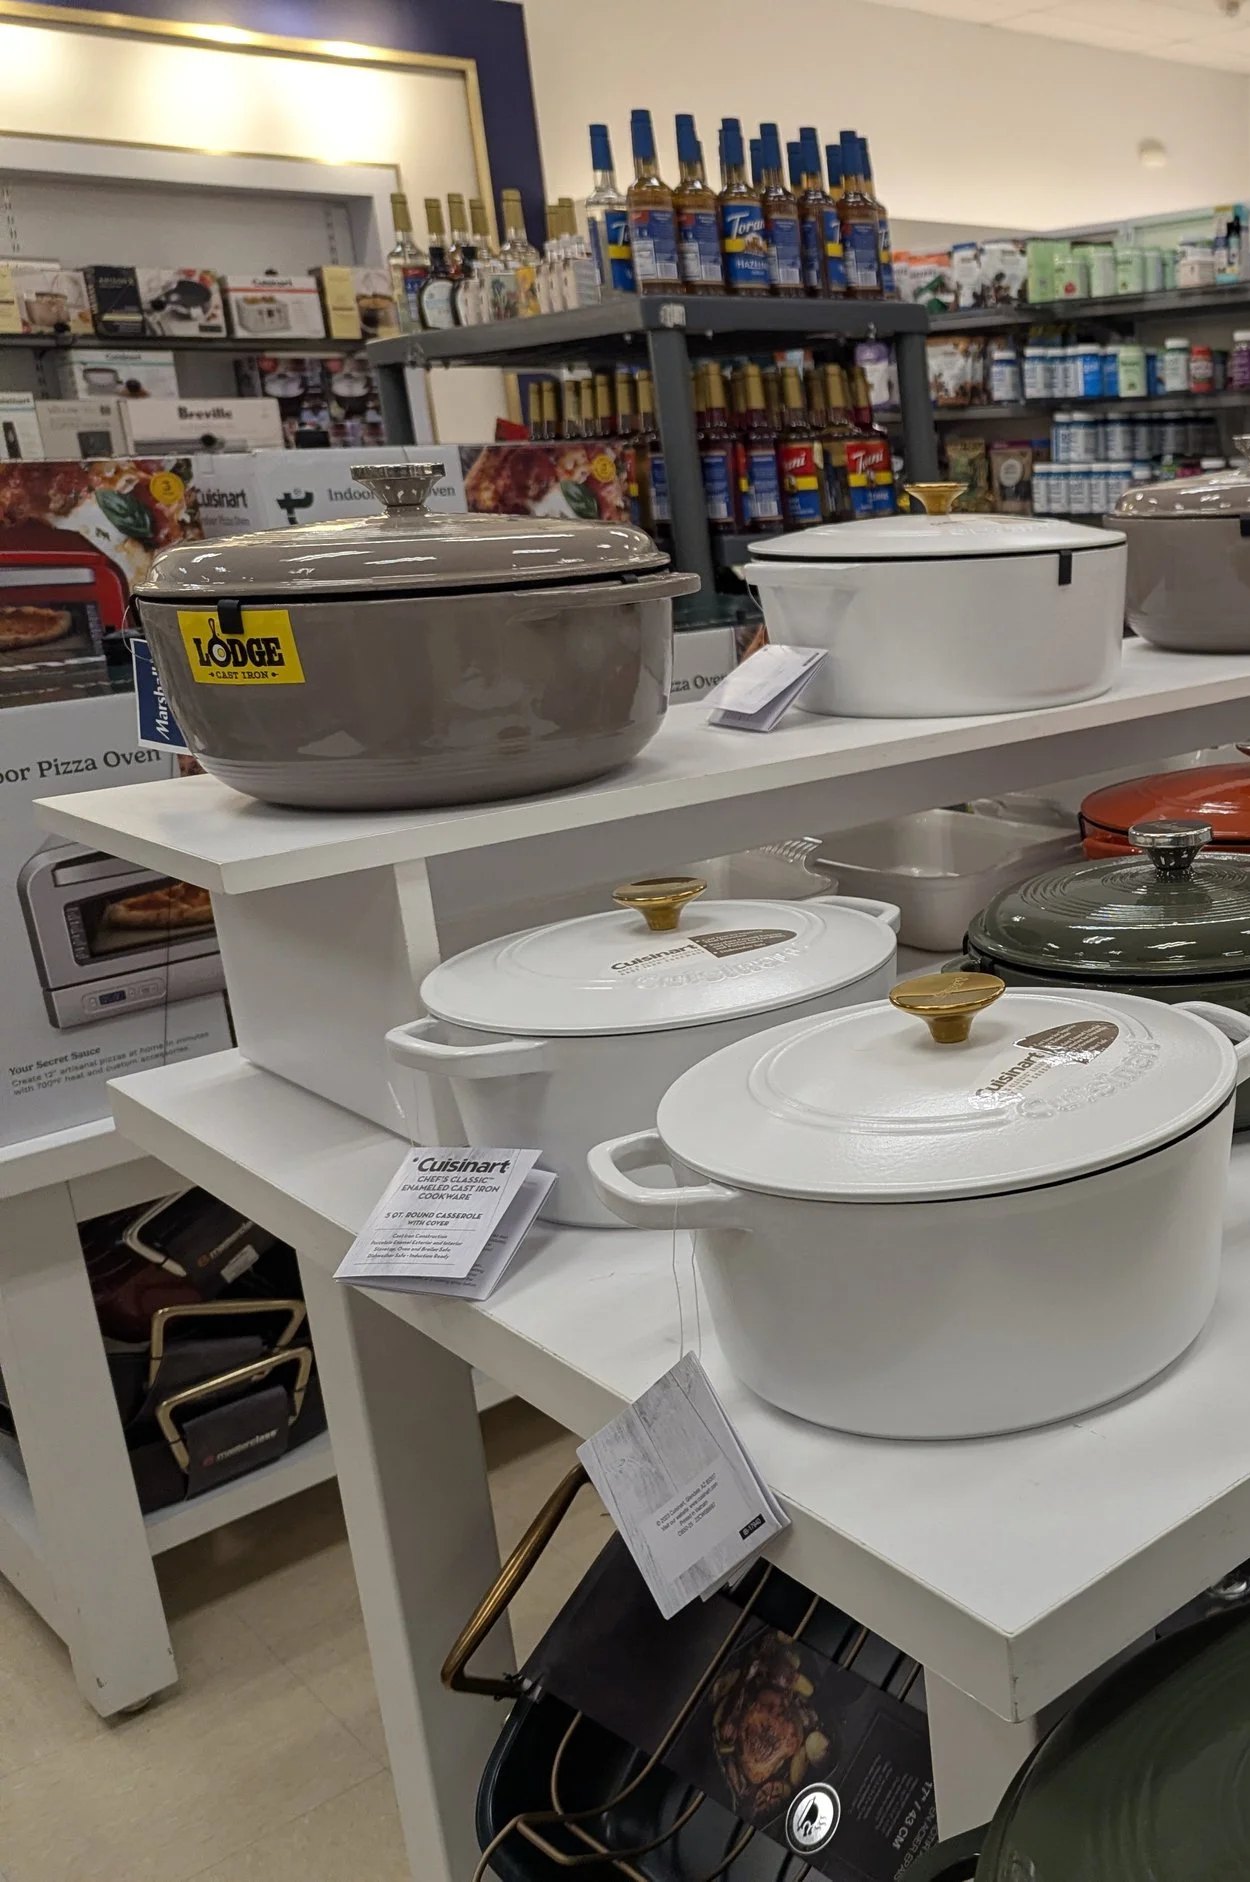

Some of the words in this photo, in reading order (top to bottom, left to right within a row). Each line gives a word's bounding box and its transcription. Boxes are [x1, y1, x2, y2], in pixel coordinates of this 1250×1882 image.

[727, 211, 765, 239] Toran
[178, 407, 232, 420] Breville
[192, 630, 285, 668] LODGE
[215, 671, 239, 680] CAST
[241, 671, 269, 680] IRON
[37, 757, 98, 779] Pizza
[103, 749, 161, 768] Oven
[611, 944, 700, 970] Cuisinart
[8, 1064, 34, 1076] Your
[36, 1054, 69, 1069] Secret
[70, 1047, 100, 1060] Sauce
[976, 1051, 1045, 1099] Cuisinart
[415, 1157, 511, 1174] Cuisinart
[417, 1175, 449, 1183] CHEF'S
[401, 1184, 450, 1192] ENAMELED
[450, 1184, 475, 1192] CAST
[475, 1185, 500, 1193] IRON
[418, 1192, 472, 1200] COOKWARE
[405, 1211, 435, 1219] ROUND
[435, 1212, 483, 1220] CASSEROLE
[905, 1809, 917, 1826] 43
[892, 1826, 909, 1850] CM
